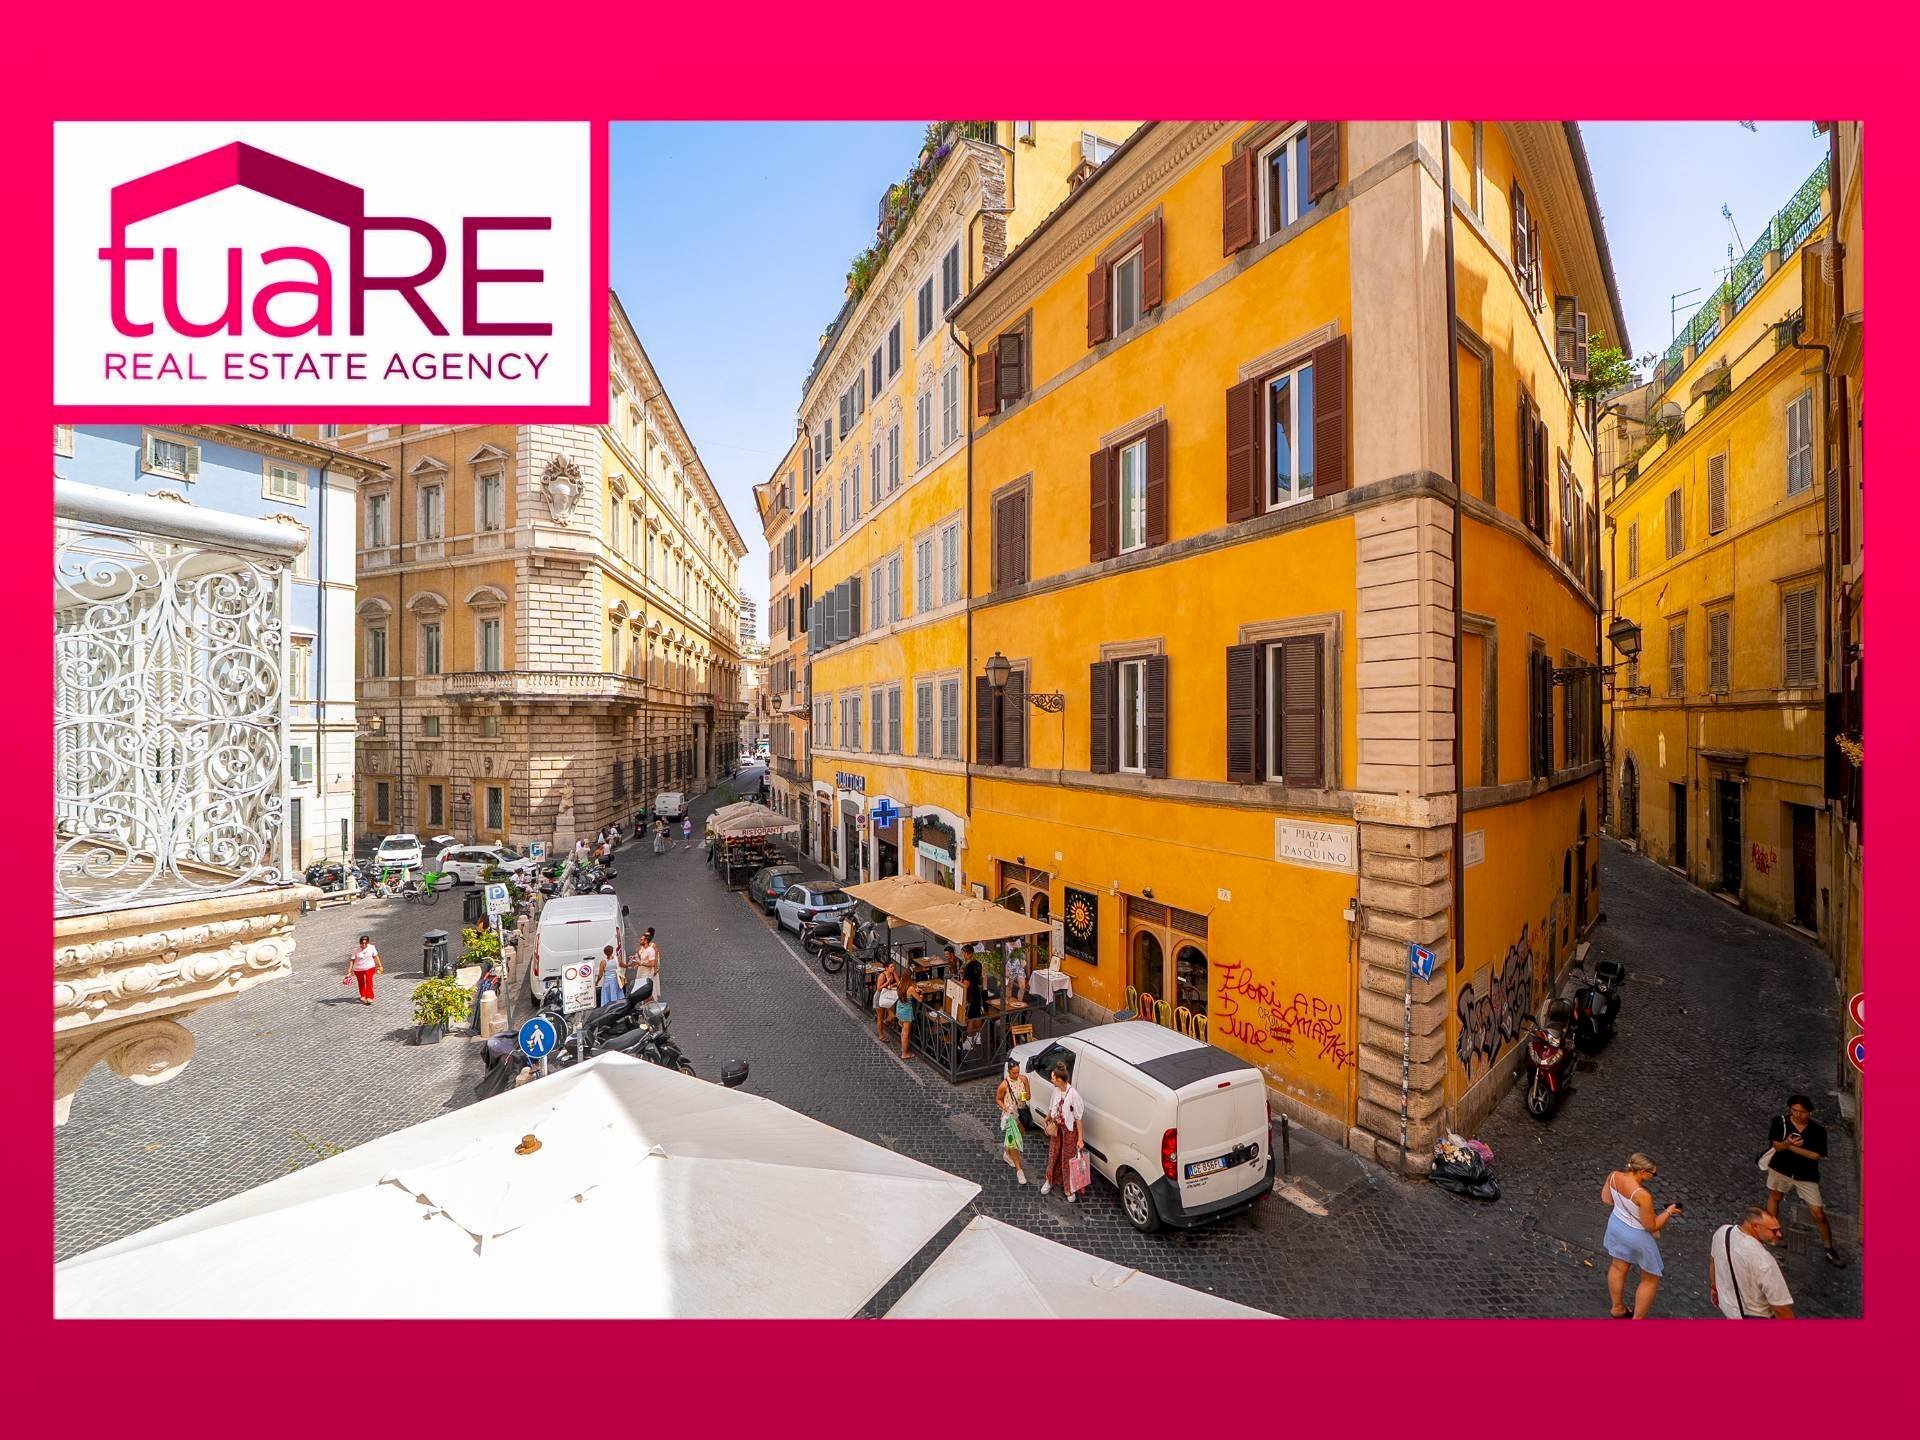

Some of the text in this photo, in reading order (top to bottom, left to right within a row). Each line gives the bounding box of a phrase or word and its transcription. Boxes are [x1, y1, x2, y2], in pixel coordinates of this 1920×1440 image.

[742, 826, 784, 836] RISTORANTE
[1295, 829, 1333, 842] PIAZZA
[1284, 845, 1347, 863] PASQUINO
